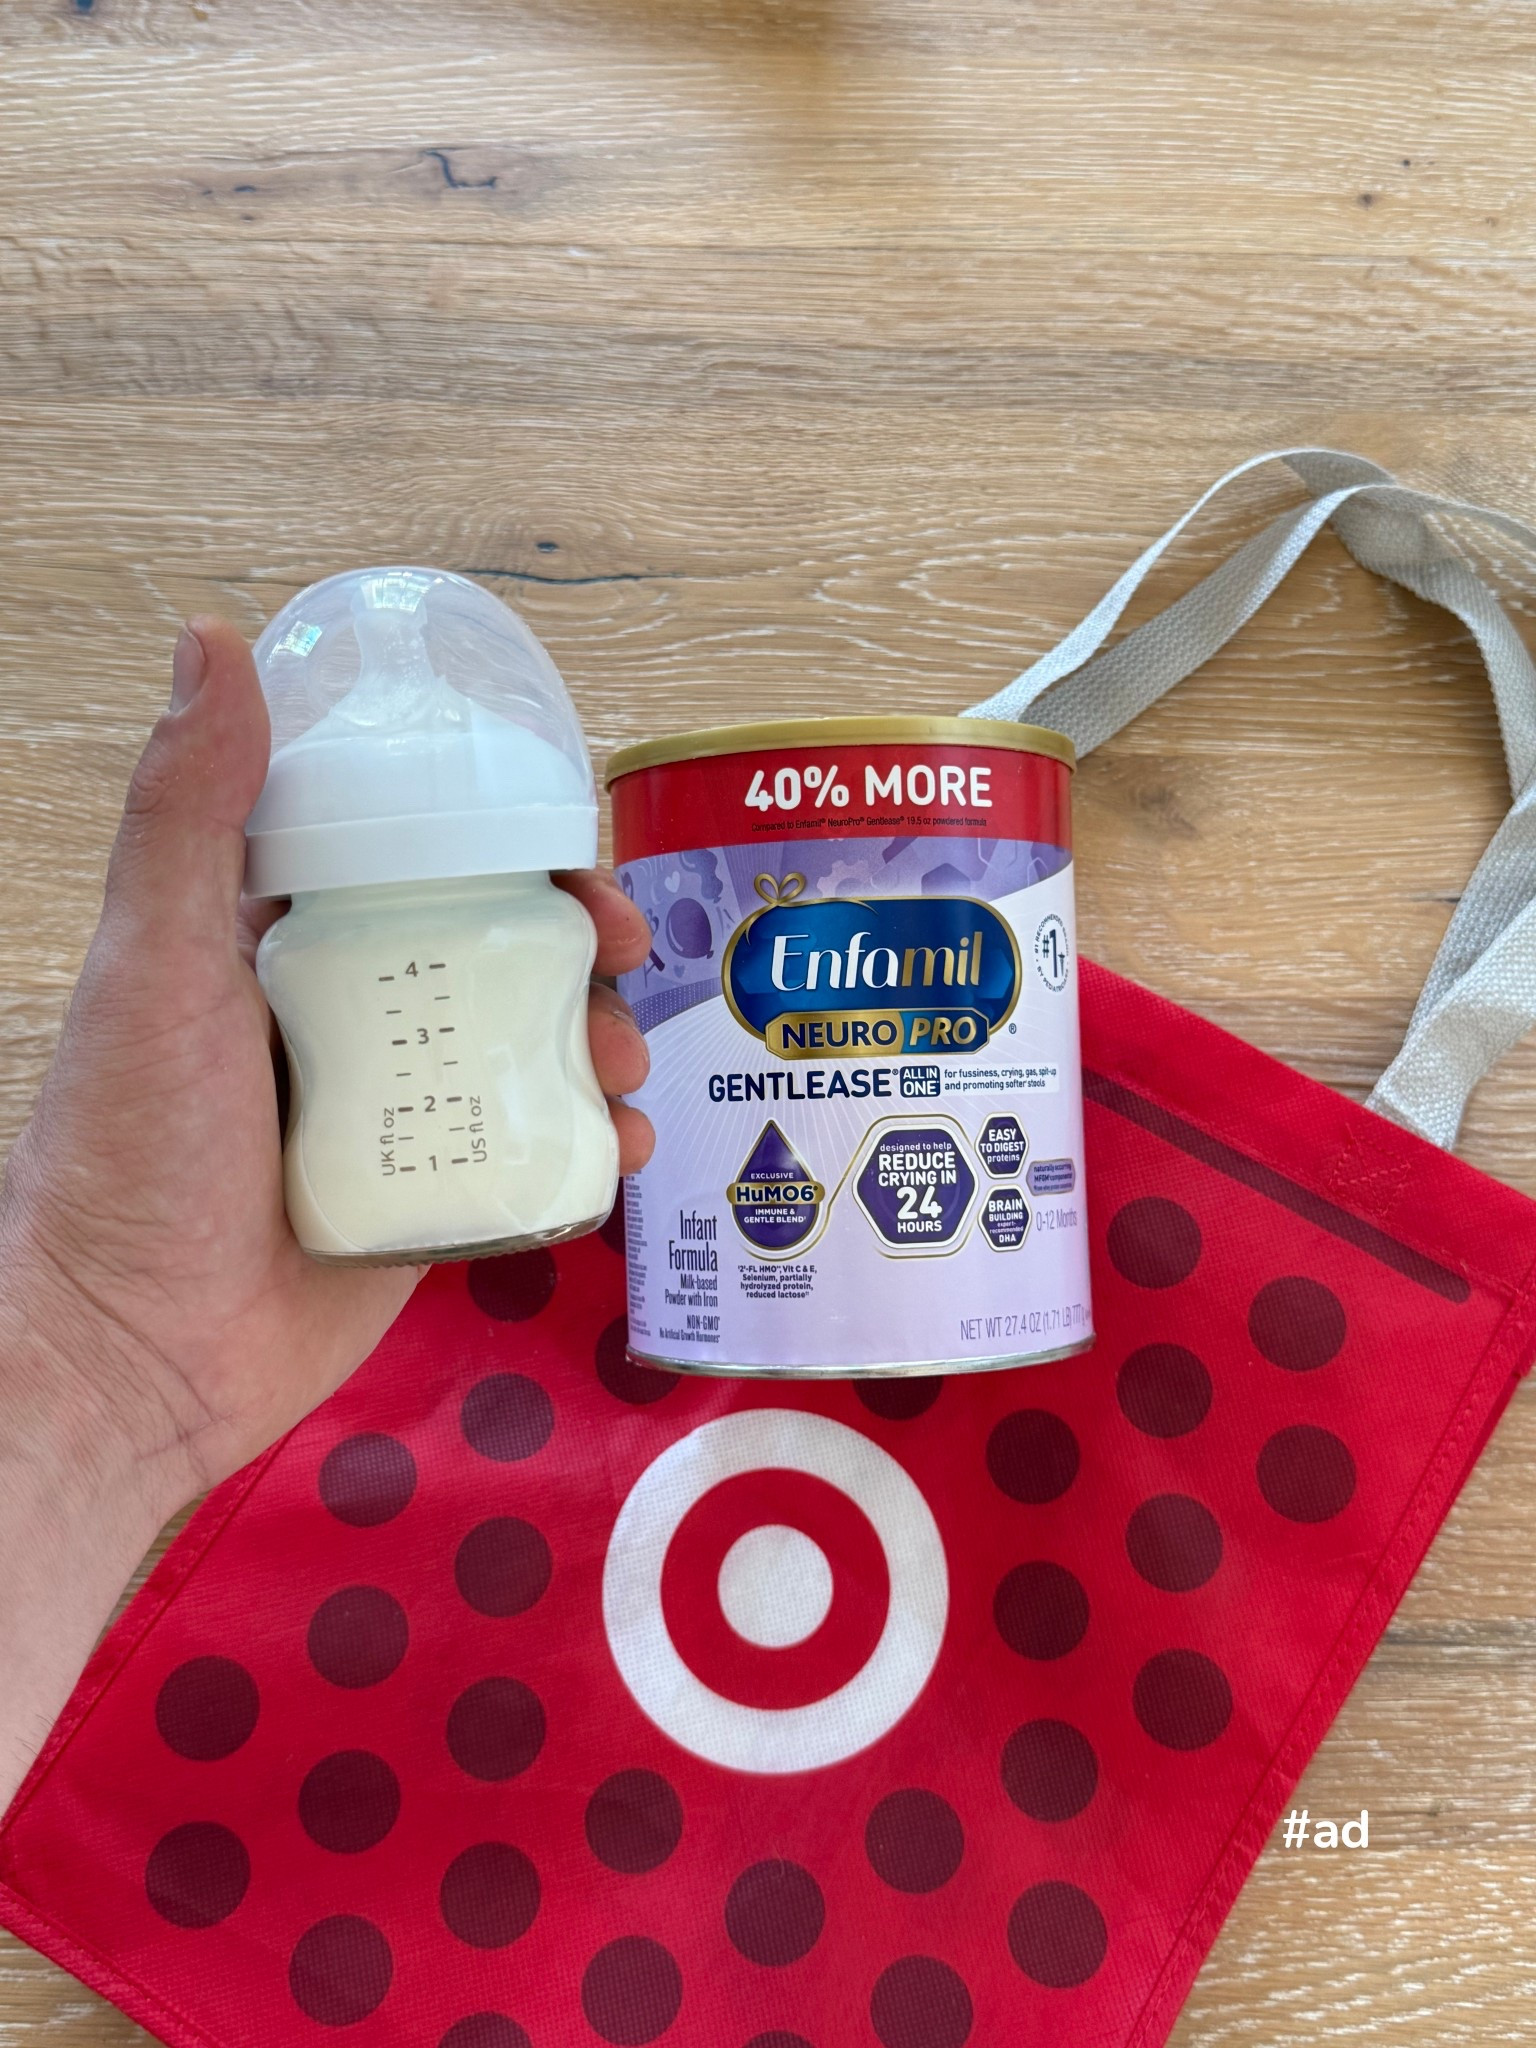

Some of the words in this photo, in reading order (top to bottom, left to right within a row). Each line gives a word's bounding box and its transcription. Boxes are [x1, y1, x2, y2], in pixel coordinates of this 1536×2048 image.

[744, 764, 850, 812] 40%
[864, 764, 993, 808] MORE
[751, 821, 786, 833] Compared
[787, 820, 795, 830] to
[906, 816, 922, 825] 19.5
[932, 817, 964, 827] powdered
[964, 817, 987, 826] formula
[771, 930, 983, 992] Enfamil
[405, 961, 419, 978] 4
[416, 1028, 430, 1045] 3
[782, 1019, 898, 1050] NEURO
[909, 1017, 977, 1047] PRO
[902, 1068, 925, 1080] ALL
[926, 1067, 938, 1079] IN
[944, 1069, 956, 1079] for
[958, 1068, 1000, 1080] fussiness,
[1001, 1067, 1025, 1079] crying,
[1025, 1068, 1038, 1078] gas,
[1039, 1066, 1057, 1077] spit-up
[944, 1081, 961, 1091] and
[962, 1080, 1004, 1092] promoting
[1027, 1078, 1046, 1088] stools
[423, 1095, 437, 1113] 2
[469, 1095, 482, 1117] oz
[383, 1107, 395, 1129] oz
[468, 1120, 484, 1134] fl
[379, 1132, 395, 1145] fl
[988, 1128, 1017, 1142] EASY
[471, 1137, 488, 1163] US
[880, 1143, 921, 1153] designed
[922, 1142, 931, 1151] to
[933, 1141, 952, 1151] help
[980, 1143, 993, 1153] TO
[994, 1141, 1025, 1152] DIGEST
[380, 1149, 396, 1177] UK
[428, 1155, 438, 1171] 1
[878, 1151, 956, 1171] REDUCE
[987, 1153, 1021, 1165] proteins
[750, 1172, 794, 1180] EXCLUSIVE
[878, 1170, 937, 1187] CRYING
[940, 1169, 957, 1185] IN
[896, 1185, 943, 1220] 24
[988, 1199, 1023, 1213] BRAIN
[755, 1208, 788, 1216] IMMUNE
[789, 1208, 796, 1216] &
[988, 1211, 1023, 1222] BUILDING
[680, 1209, 718, 1241] Infant
[743, 1216, 774, 1224] GENTLE
[897, 1220, 943, 1234] HOURS
[1035, 1209, 1055, 1232] 0-12
[989, 1225, 1024, 1234] recommended
[998, 1233, 1017, 1244] DHA
[668, 1240, 719, 1272] Formula
[782, 1265, 794, 1273] Vit
[795, 1265, 801, 1273] C
[810, 1265, 817, 1274] E,
[680, 1273, 718, 1292] Milk-based
[742, 1274, 778, 1283] Selenium,
[780, 1273, 812, 1283] partially
[740, 1282, 780, 1291] hydrolyzed
[783, 1282, 814, 1291] protein,
[664, 1288, 687, 1306] Powder
[688, 1291, 703, 1307] with
[703, 1291, 718, 1308] Iron
[960, 1318, 983, 1341] NET
[985, 1316, 1002, 1338] WT
[1004, 1313, 1027, 1337] 27.4
[1029, 1311, 1041, 1333] OZ
[1043, 1309, 1060, 1335] (1.71
[681, 1329, 696, 1341] Growth
